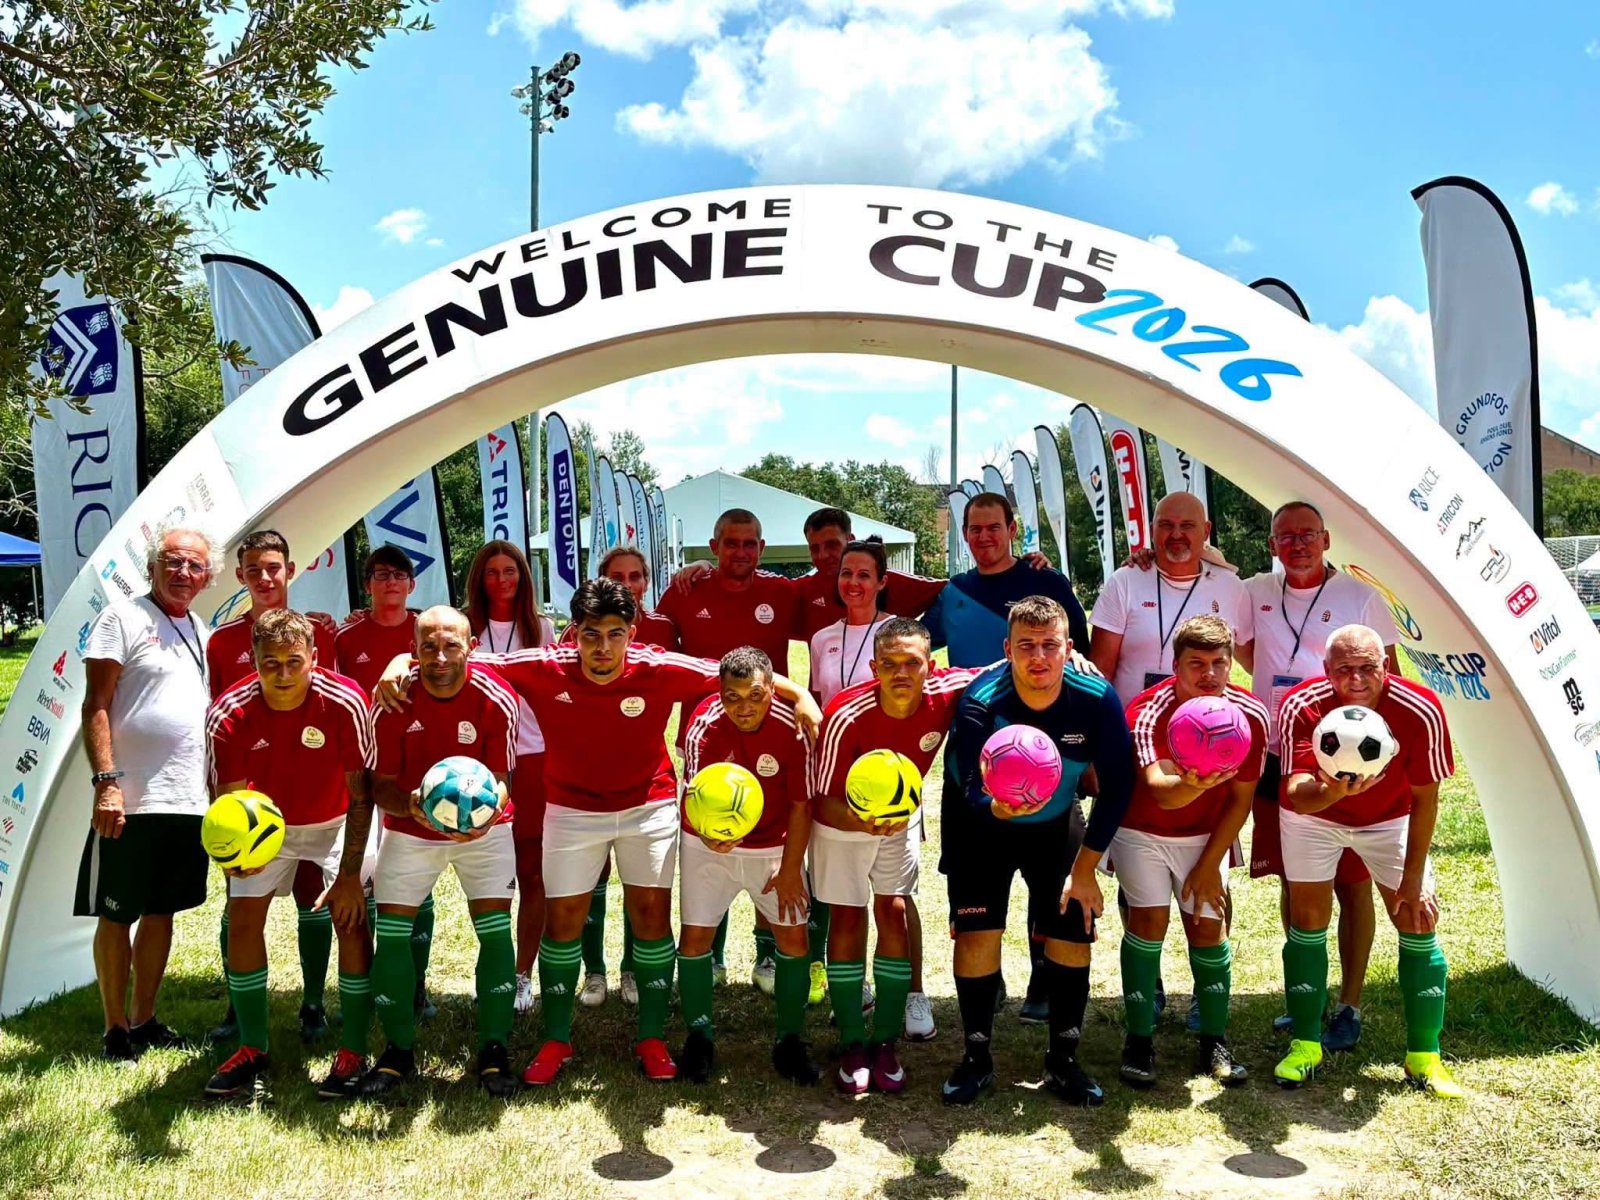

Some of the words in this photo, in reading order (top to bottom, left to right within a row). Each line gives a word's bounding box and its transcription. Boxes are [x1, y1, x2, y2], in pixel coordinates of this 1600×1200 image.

[450, 198, 791, 284] WELCOME
[866, 204, 954, 231] TO
[986, 220, 1118, 273] THE
[282, 227, 788, 436] GENUINE
[868, 234, 1108, 312] CUP
[1074, 288, 1304, 402] 2026
[1456, 392, 1509, 436] GRUNDFOS
[1483, 442, 1513, 474] TION
[67, 425, 113, 576] RIC
[490, 459, 509, 542] TRIC
[1418, 465, 1442, 497] RICE
[375, 477, 436, 578] VA
[557, 462, 575, 572] DENTONS
[1439, 493, 1465, 532] TRICON
[112, 571, 134, 599] MAERSK
[1537, 614, 1562, 646] Vitol
[1446, 652, 1486, 677] CUP
[1455, 671, 1491, 701] 2026
[27, 714, 51, 745] BBVA
